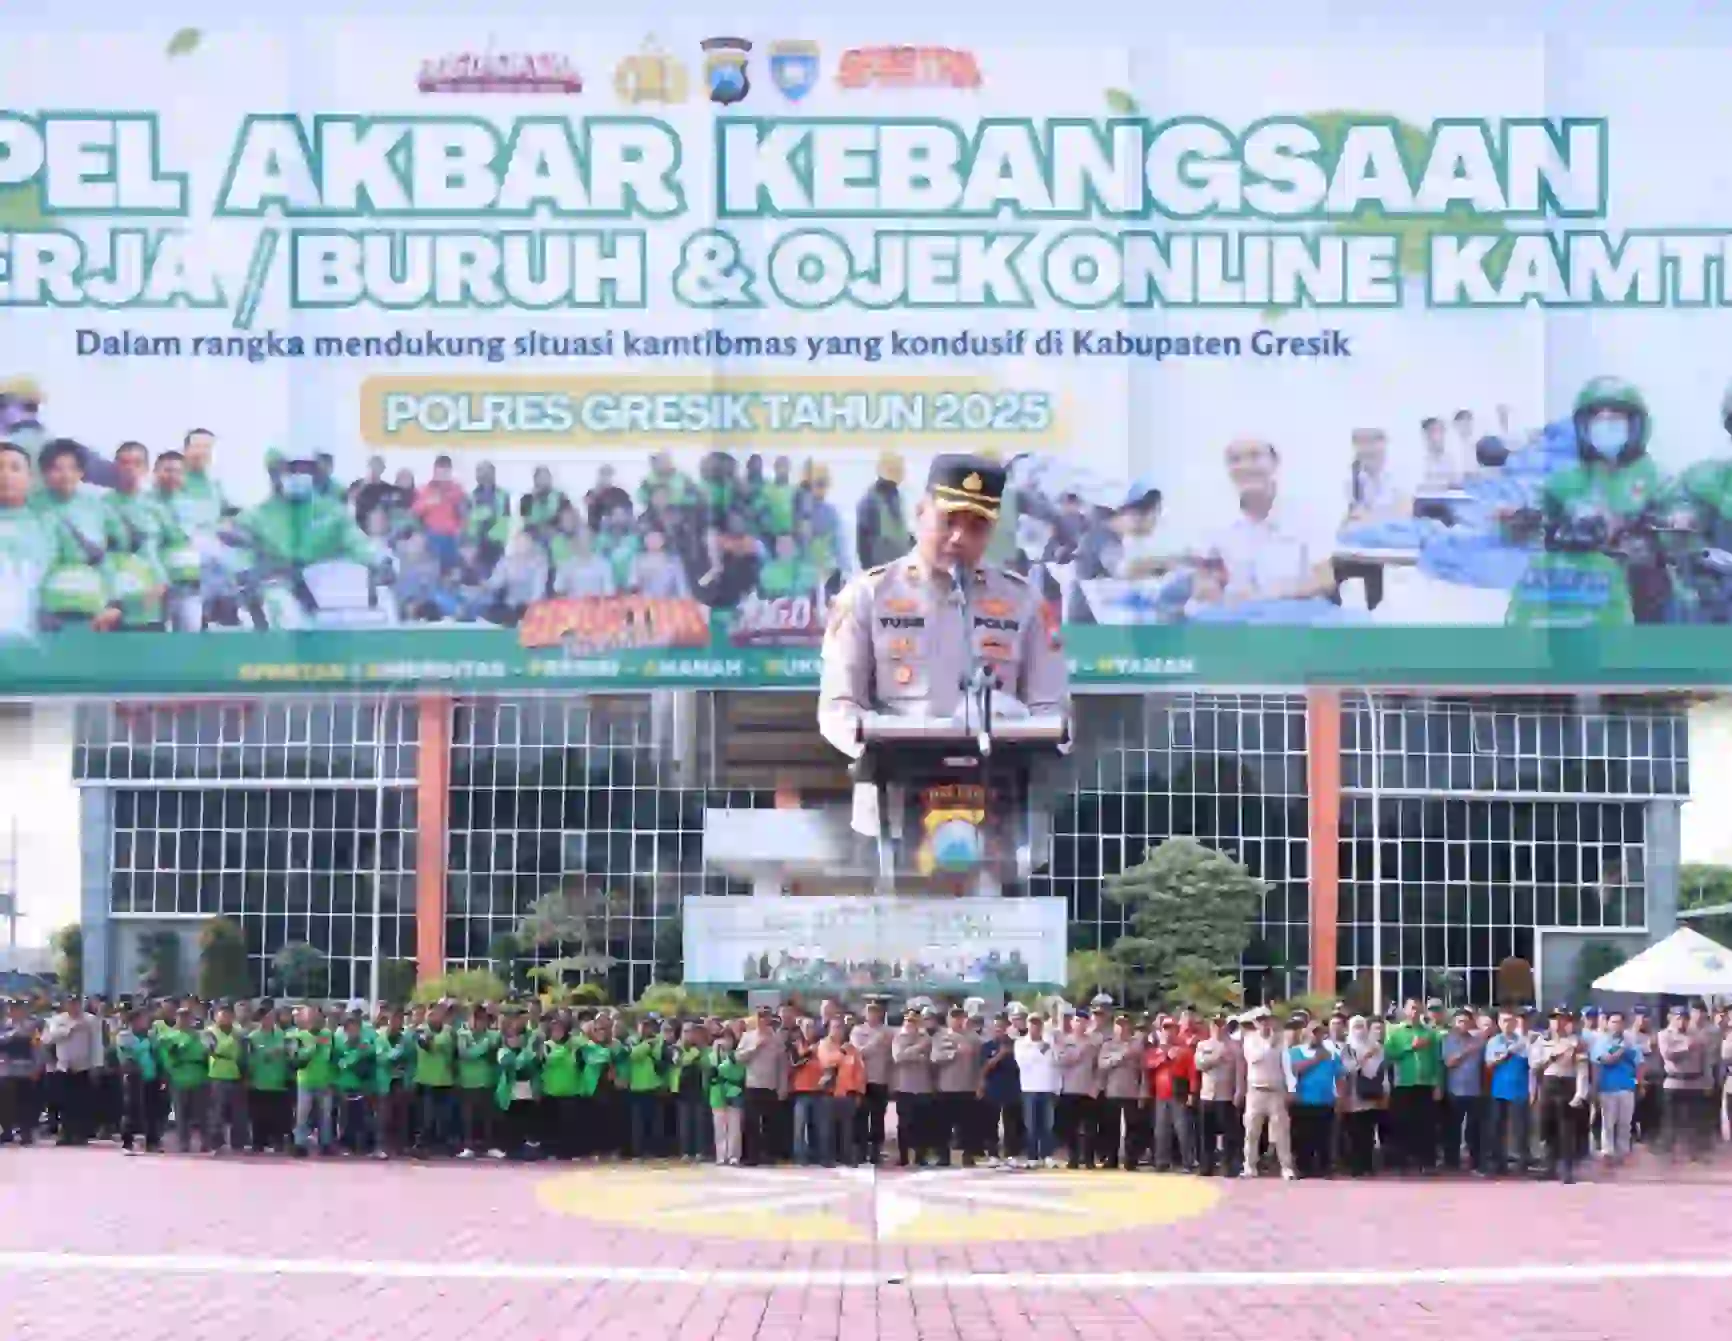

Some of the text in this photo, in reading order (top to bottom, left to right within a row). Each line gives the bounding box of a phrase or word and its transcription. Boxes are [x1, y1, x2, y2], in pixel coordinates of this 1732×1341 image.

[0, 110, 1608, 220] PEL AKBAR KEBANGSAAN
[672, 228, 766, 309] &
[768, 228, 1036, 310] OJEK
[1041, 228, 1402, 310] ONLINE
[76, 329, 1351, 363] Dalam rangka mendukung situasi kamtibmas yang kondusif di Kabupaten Gresik
[384, 391, 1050, 433] POLRES GRESIK TAHUN 2025
